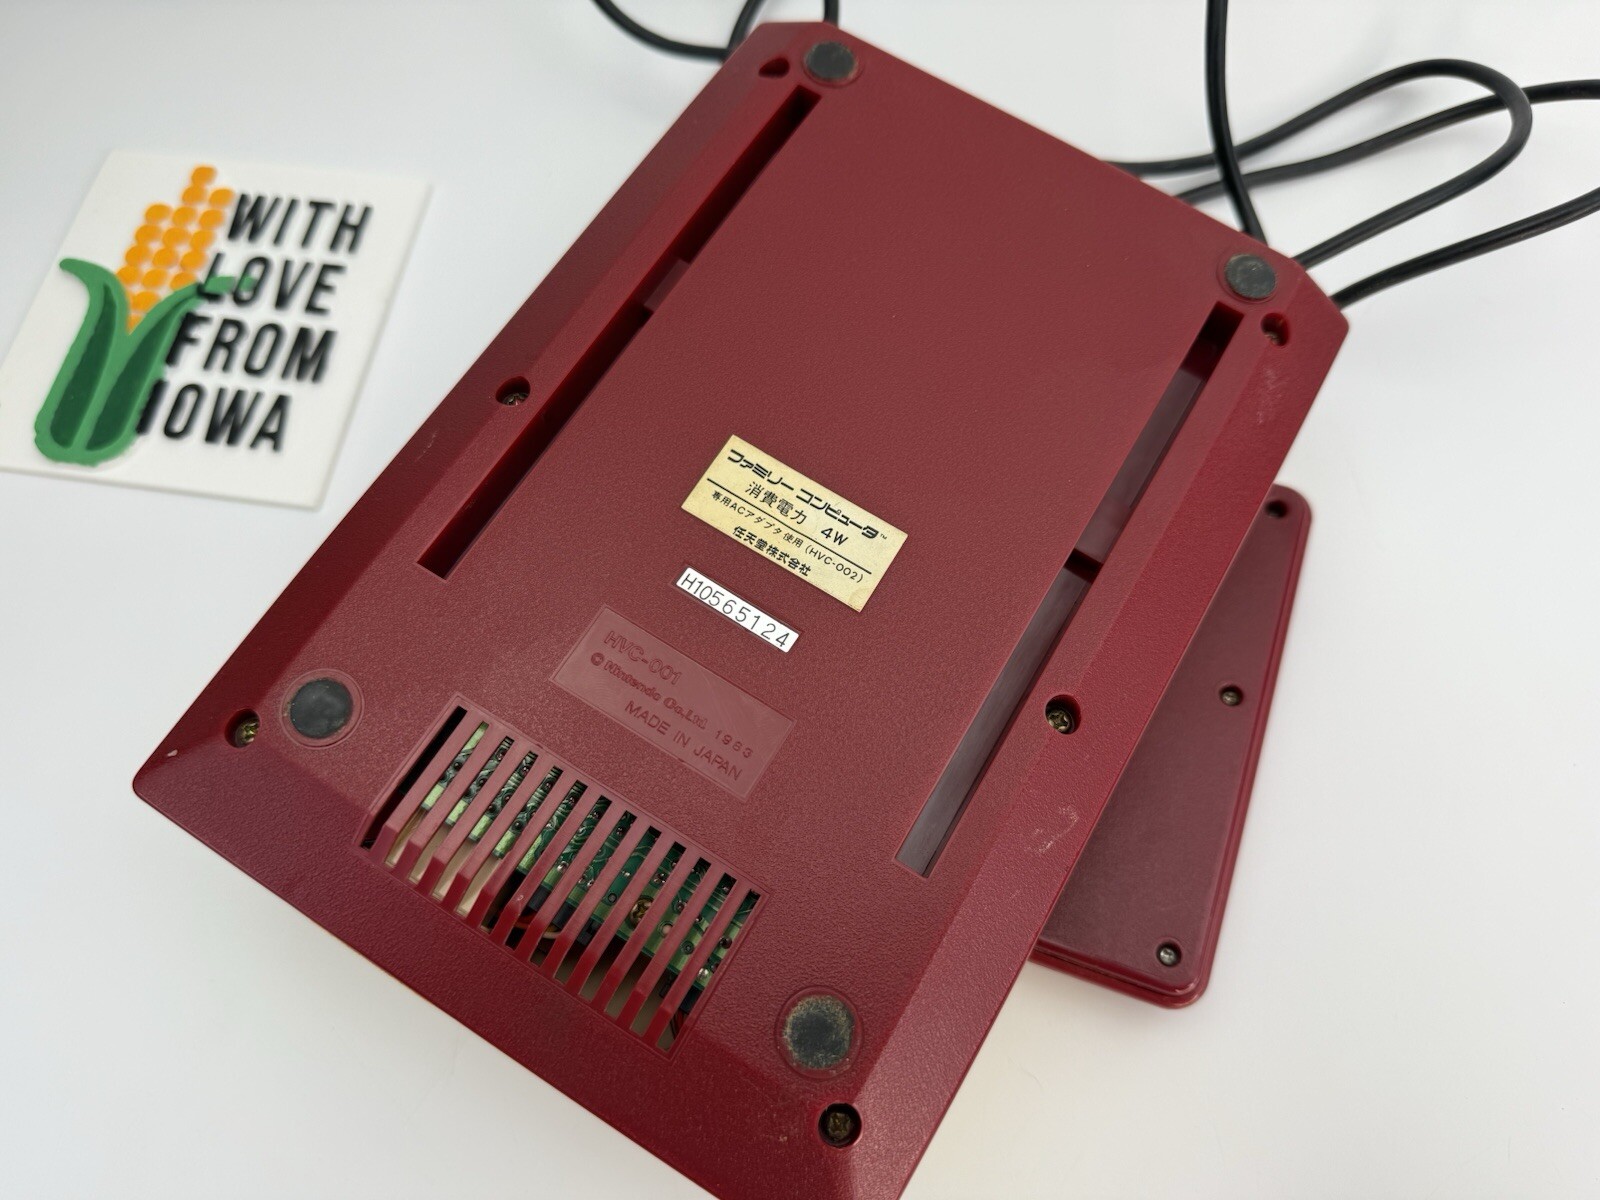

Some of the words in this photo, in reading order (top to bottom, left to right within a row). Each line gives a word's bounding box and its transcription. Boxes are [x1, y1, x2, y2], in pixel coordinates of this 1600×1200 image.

[228, 193, 373, 253] WITH
[199, 253, 346, 315] LOVE
[166, 312, 338, 383] FROM
[136, 380, 293, 452] IOWA
[727, 449, 795, 491] ファミリー
[745, 481, 808, 525] 消費電力
[820, 527, 849, 546] 4W
[732, 526, 812, 577] 任天堂株式会社
[680, 573, 790, 648] H10565124
[603, 630, 682, 686] HVC-001
[604, 660, 662, 701] Nintendo
[714, 729, 754, 759] 1983
[624, 700, 671, 736] MADE
[673, 730, 692, 748] IN
[693, 746, 743, 781] JAPAN
